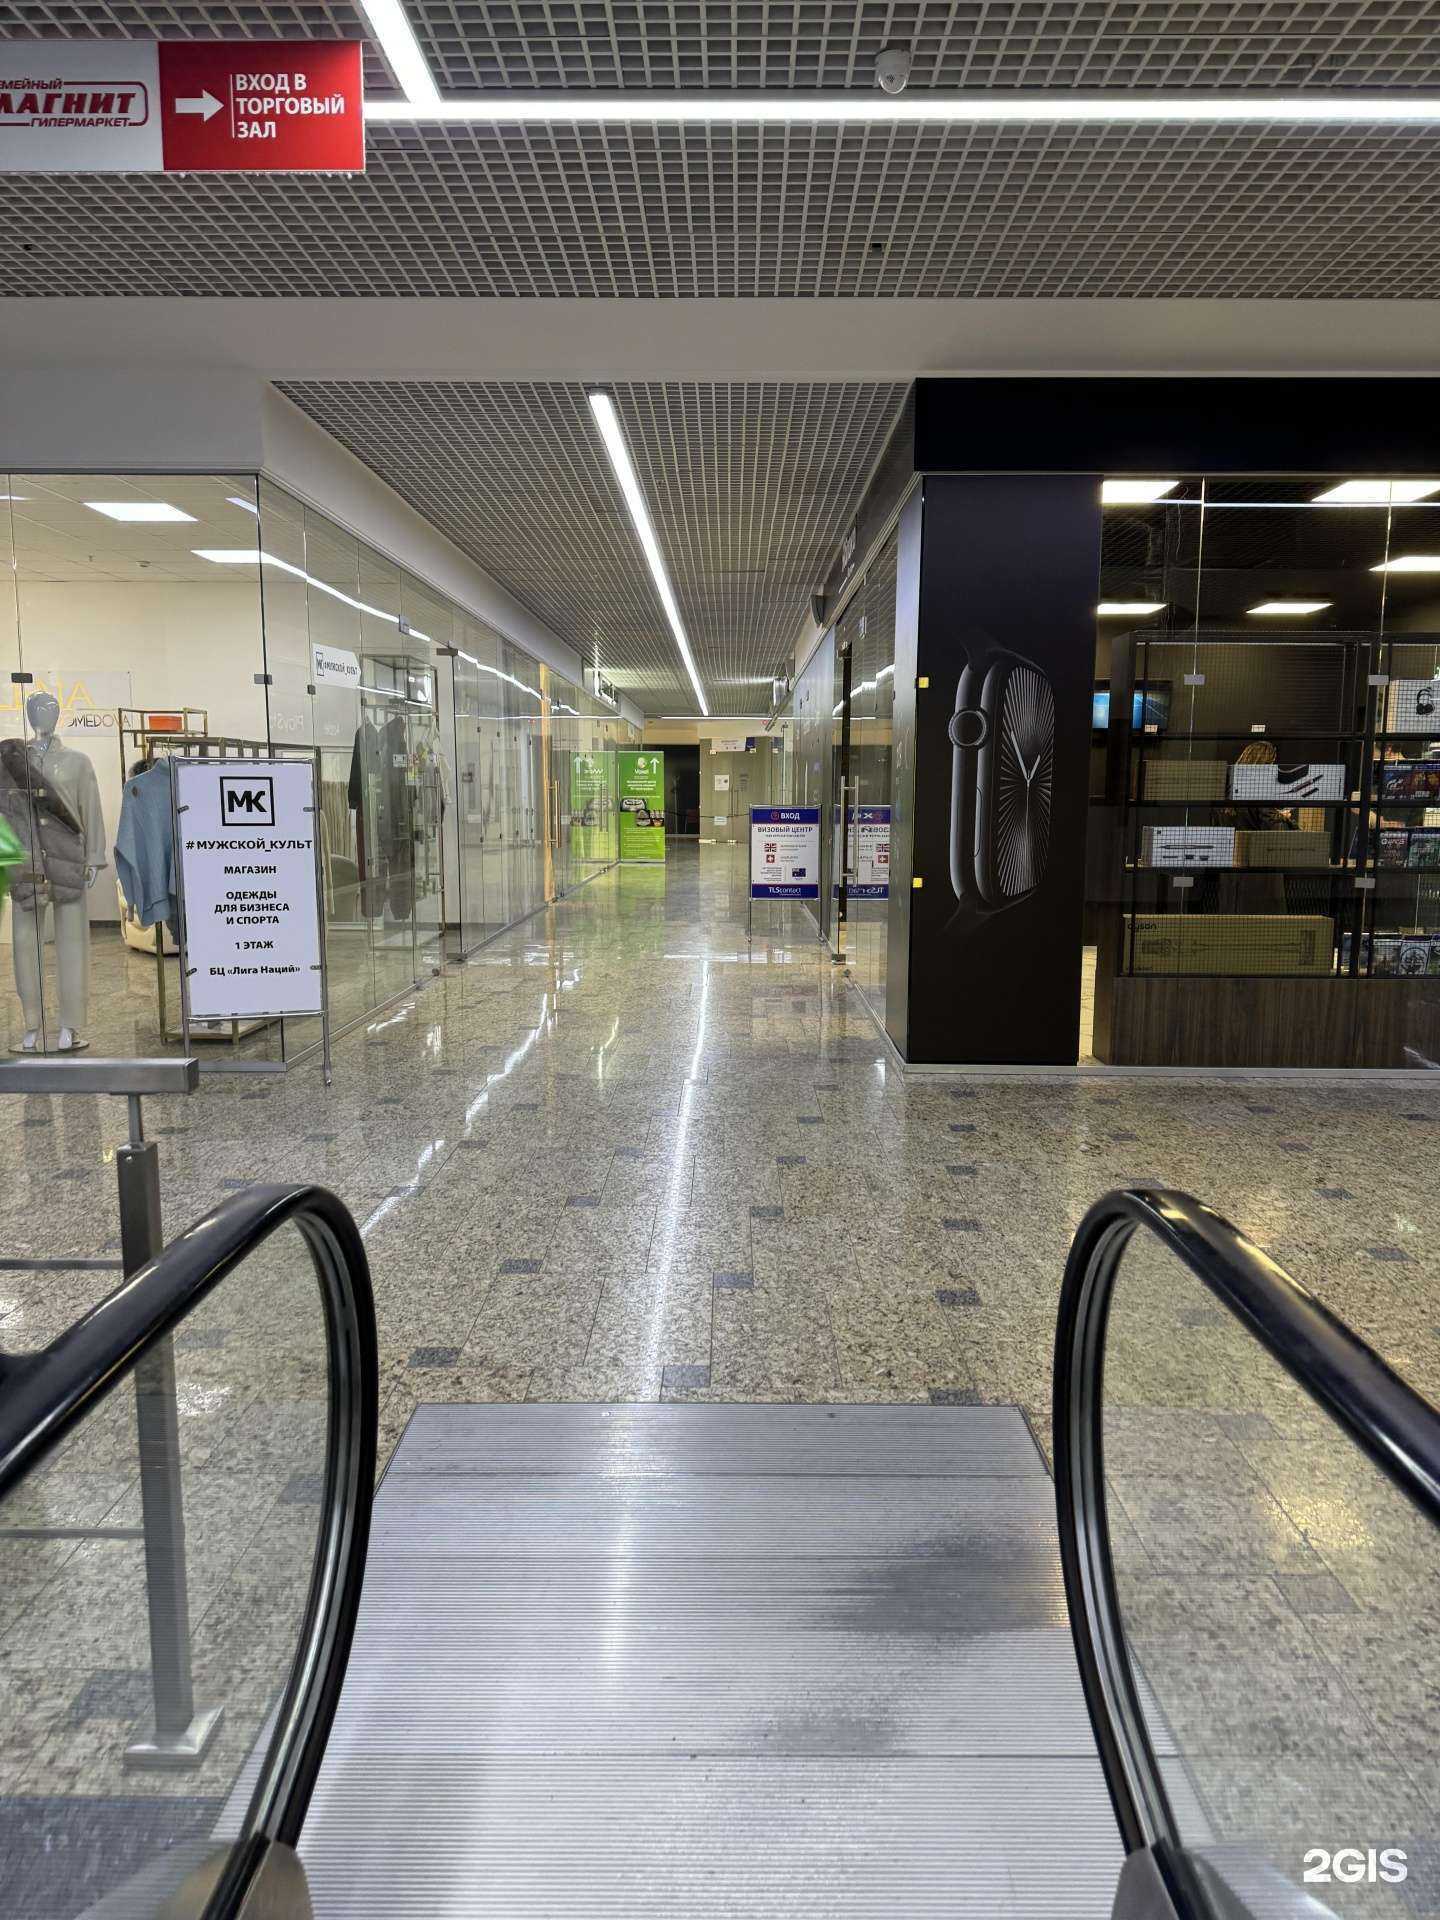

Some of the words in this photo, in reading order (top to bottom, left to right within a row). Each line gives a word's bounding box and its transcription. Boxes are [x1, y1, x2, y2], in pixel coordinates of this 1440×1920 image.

[236, 73, 290, 93] ВХОД
[295, 73, 307, 91] В
[236, 94, 345, 115] ТОРГОВЫЙ
[31, 117, 130, 127] ГИПЕРМАРКЕТ
[237, 121, 277, 139] ЗАЛ
[780, 812, 800, 821] ВХОД
[791, 826, 813, 834] ЦЕНТР
[224, 865, 277, 875] МАГАЗИН
[226, 890, 277, 901] ОДЕЖДЫ
[214, 903, 238, 914] ДЛЯ
[240, 903, 290, 912] БИЗНЕСА
[226, 917, 235, 925] И
[236, 916, 280, 925] СПОРТА
[235, 941, 241, 950] 1
[243, 940, 274, 950] ЭТАЖ
[209, 967, 226, 977] БЦ
[227, 965, 259, 976] «Лига
[260, 964, 301, 975] Наций»
